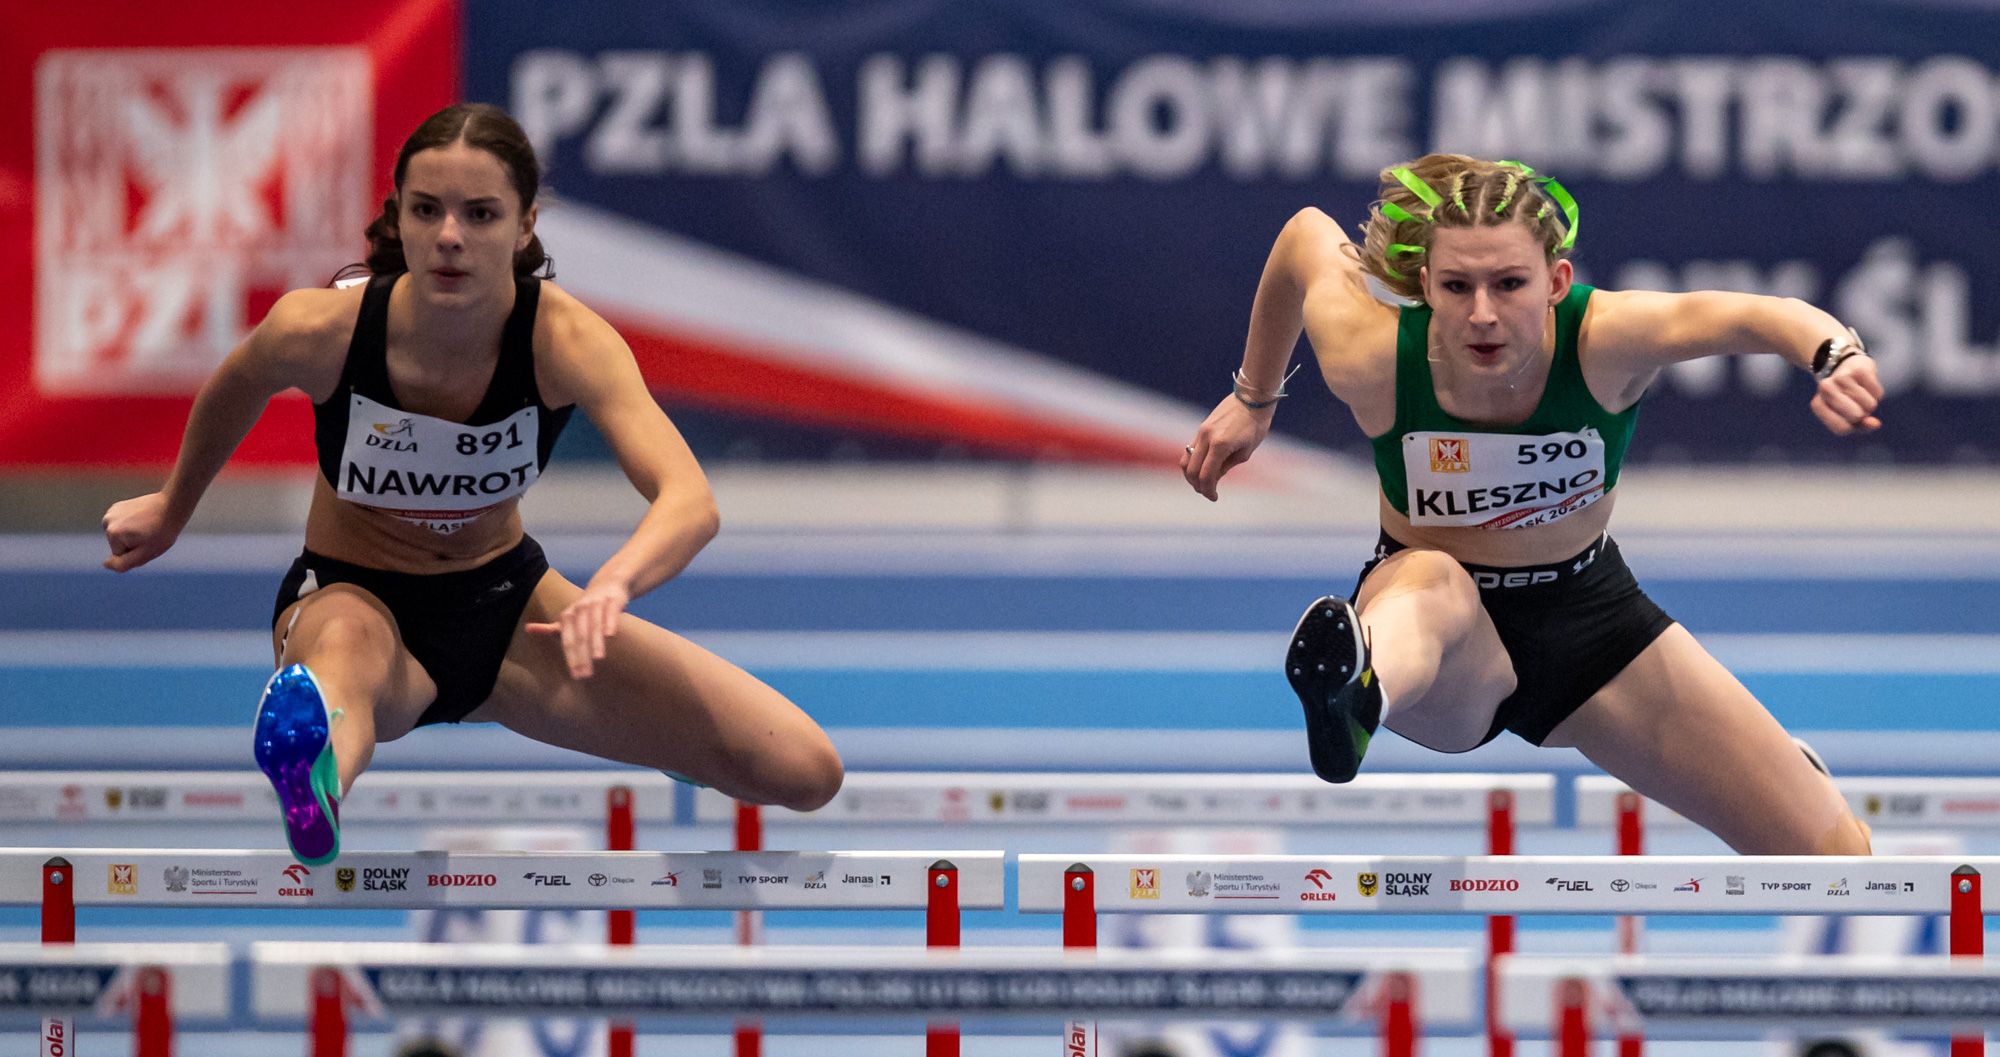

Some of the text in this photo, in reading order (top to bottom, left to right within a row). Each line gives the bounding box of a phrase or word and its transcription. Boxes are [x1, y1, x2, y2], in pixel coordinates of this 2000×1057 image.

[510, 48, 838, 174] PZLA
[856, 54, 1413, 178] HALOWE
[365, 422, 523, 456] DZLA 891
[1517, 439, 1588, 465] 590
[346, 461, 533, 496] NAWROT
[1416, 469, 1599, 517] KLESZNO
[191, 869, 242, 877] Ministerstwo
[363, 867, 410, 879] DOLNY
[841, 873, 874, 884] Janas
[1213, 873, 1264, 881] Ministerstwo
[1385, 873, 1433, 883] DOLNY
[191, 878, 217, 887] Sportu
[223, 878, 258, 888] Turystyki
[363, 878, 408, 892] ŚLĄSK
[427, 874, 497, 887] BODZIO
[737, 875, 789, 884] TVP SPORT
[1864, 880, 1897, 890] Janas
[1213, 882, 1239, 891] Sportu
[1245, 882, 1280, 892] Turystyki
[1385, 883, 1430, 897] ŚLĄSK
[1449, 879, 1520, 892] BODZIO
[1760, 882, 1812, 891] TVP SPORT
[278, 887, 314, 897] ORLEN
[1300, 892, 1336, 901] ORLEN
